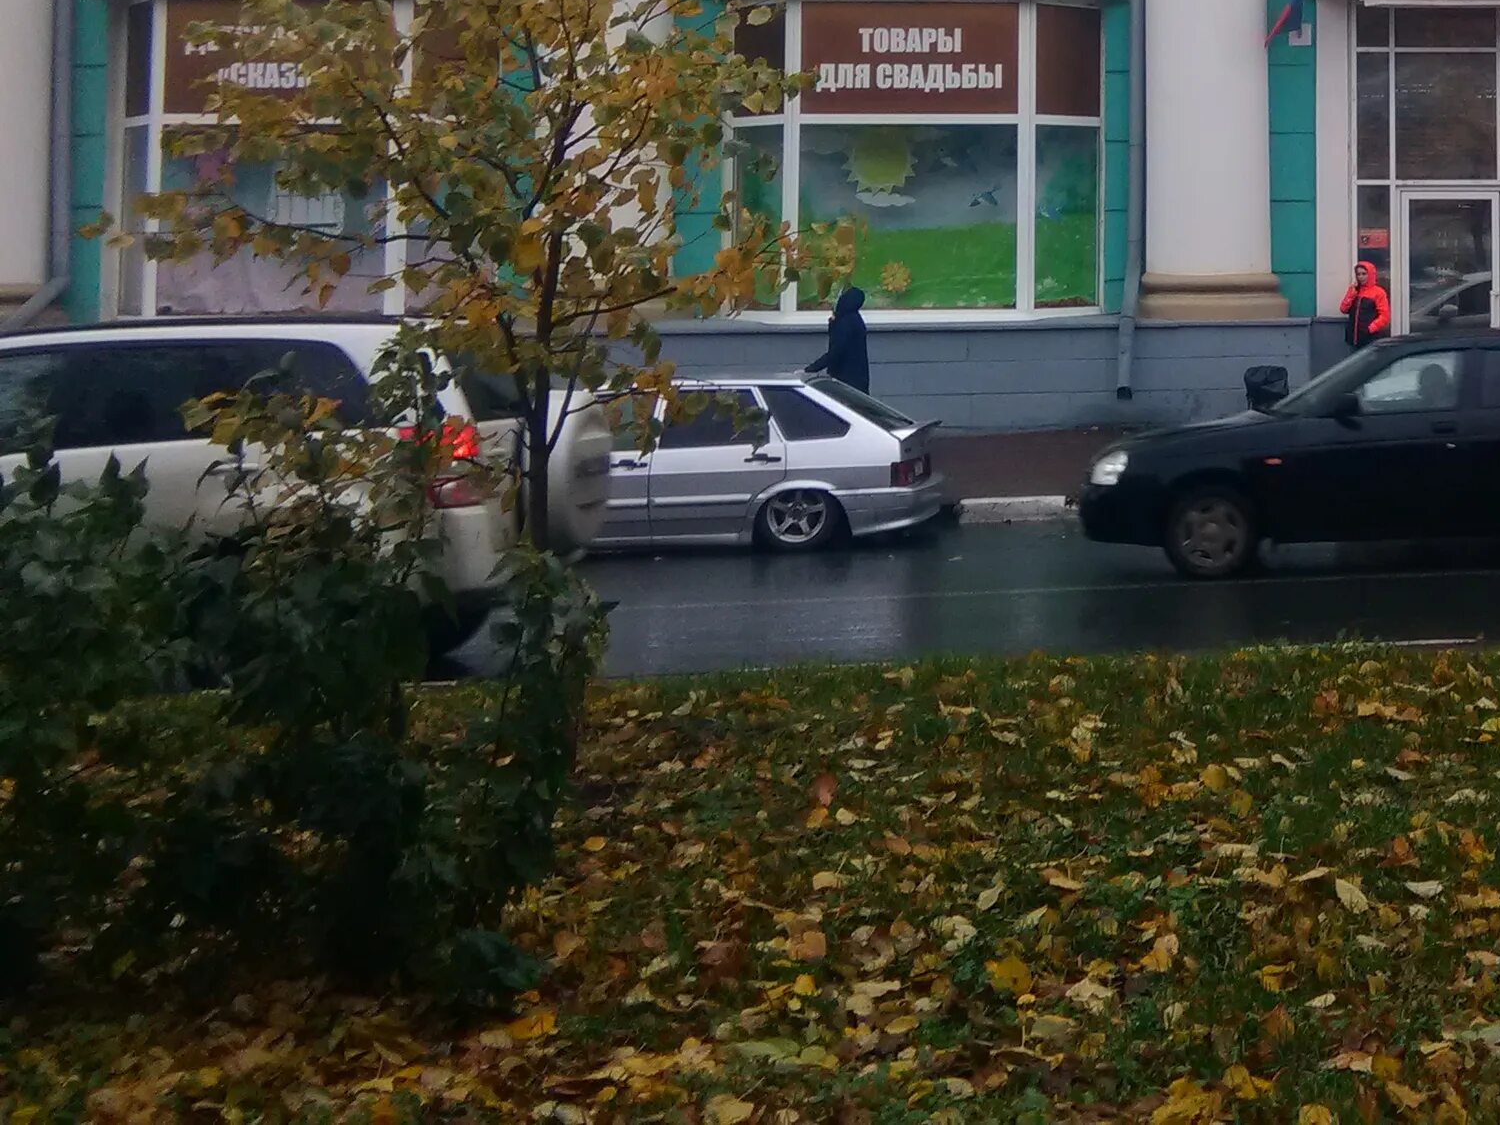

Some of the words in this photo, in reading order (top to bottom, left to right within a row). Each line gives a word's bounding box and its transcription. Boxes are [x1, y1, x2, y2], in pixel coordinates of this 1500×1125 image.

[858, 27, 962, 53] ТОВАРЫ
[815, 63, 870, 93] ДЛЯ
[876, 63, 1003, 93] СВАДЬБЫ
